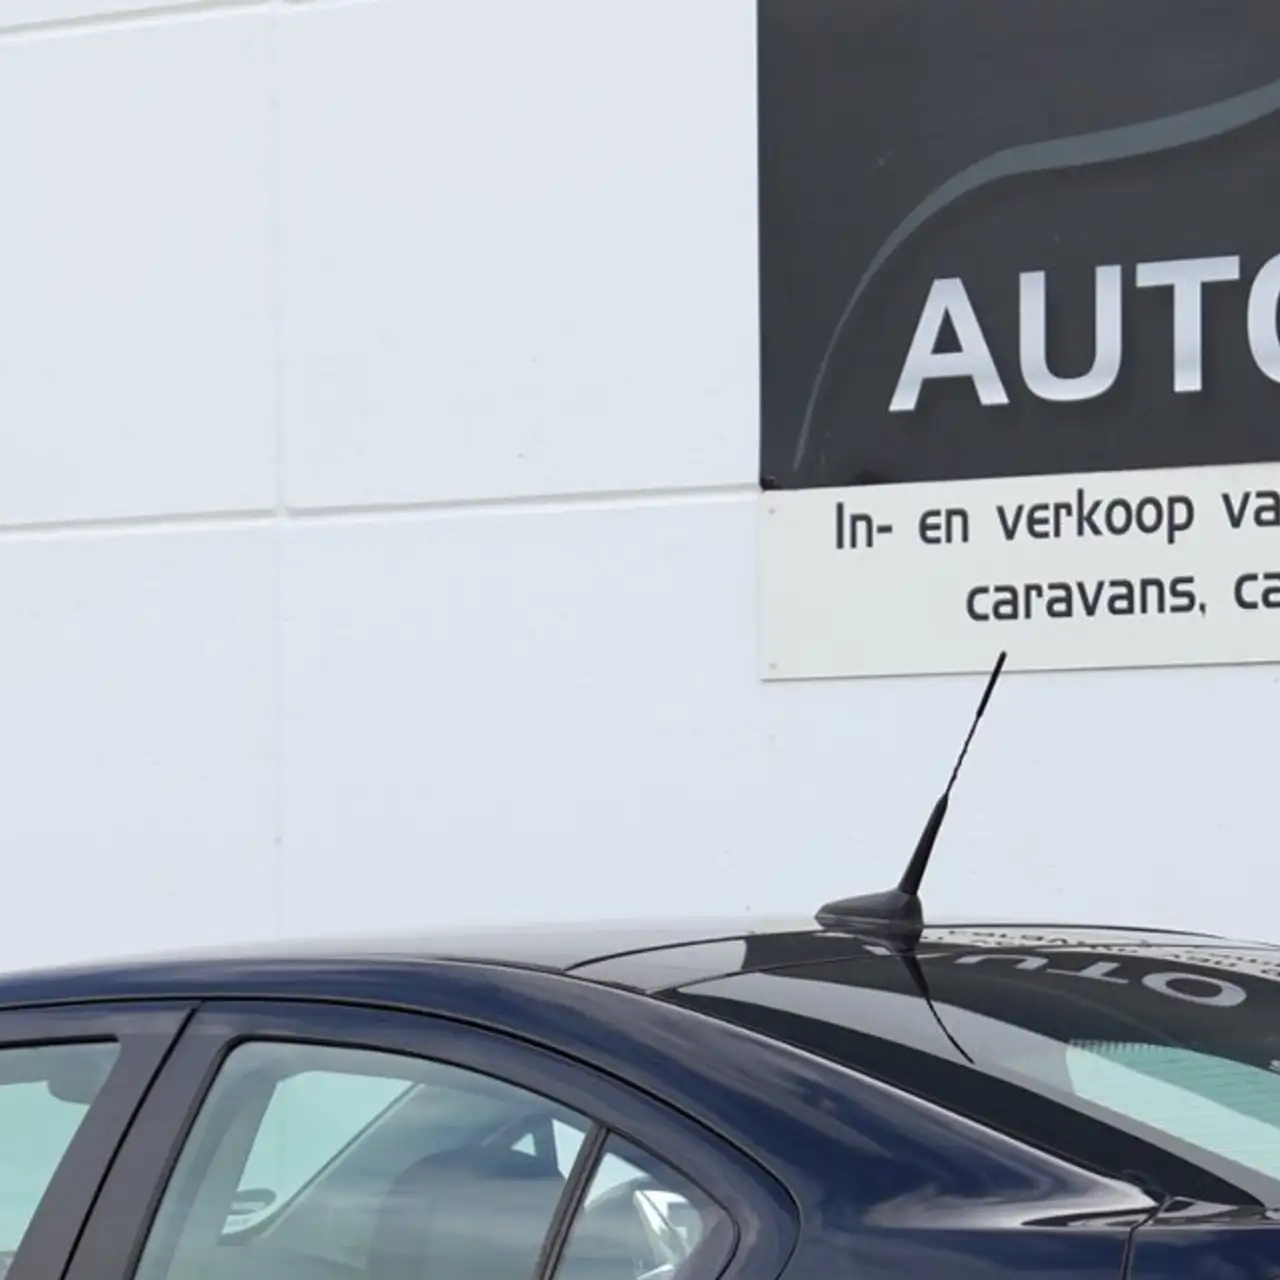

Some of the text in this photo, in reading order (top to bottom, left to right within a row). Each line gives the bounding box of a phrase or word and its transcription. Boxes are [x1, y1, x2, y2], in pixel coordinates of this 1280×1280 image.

[836, 502, 893, 550] In-
[919, 508, 969, 544] en
[996, 488, 1194, 544] verkoop
[966, 576, 1207, 621] caravans,
